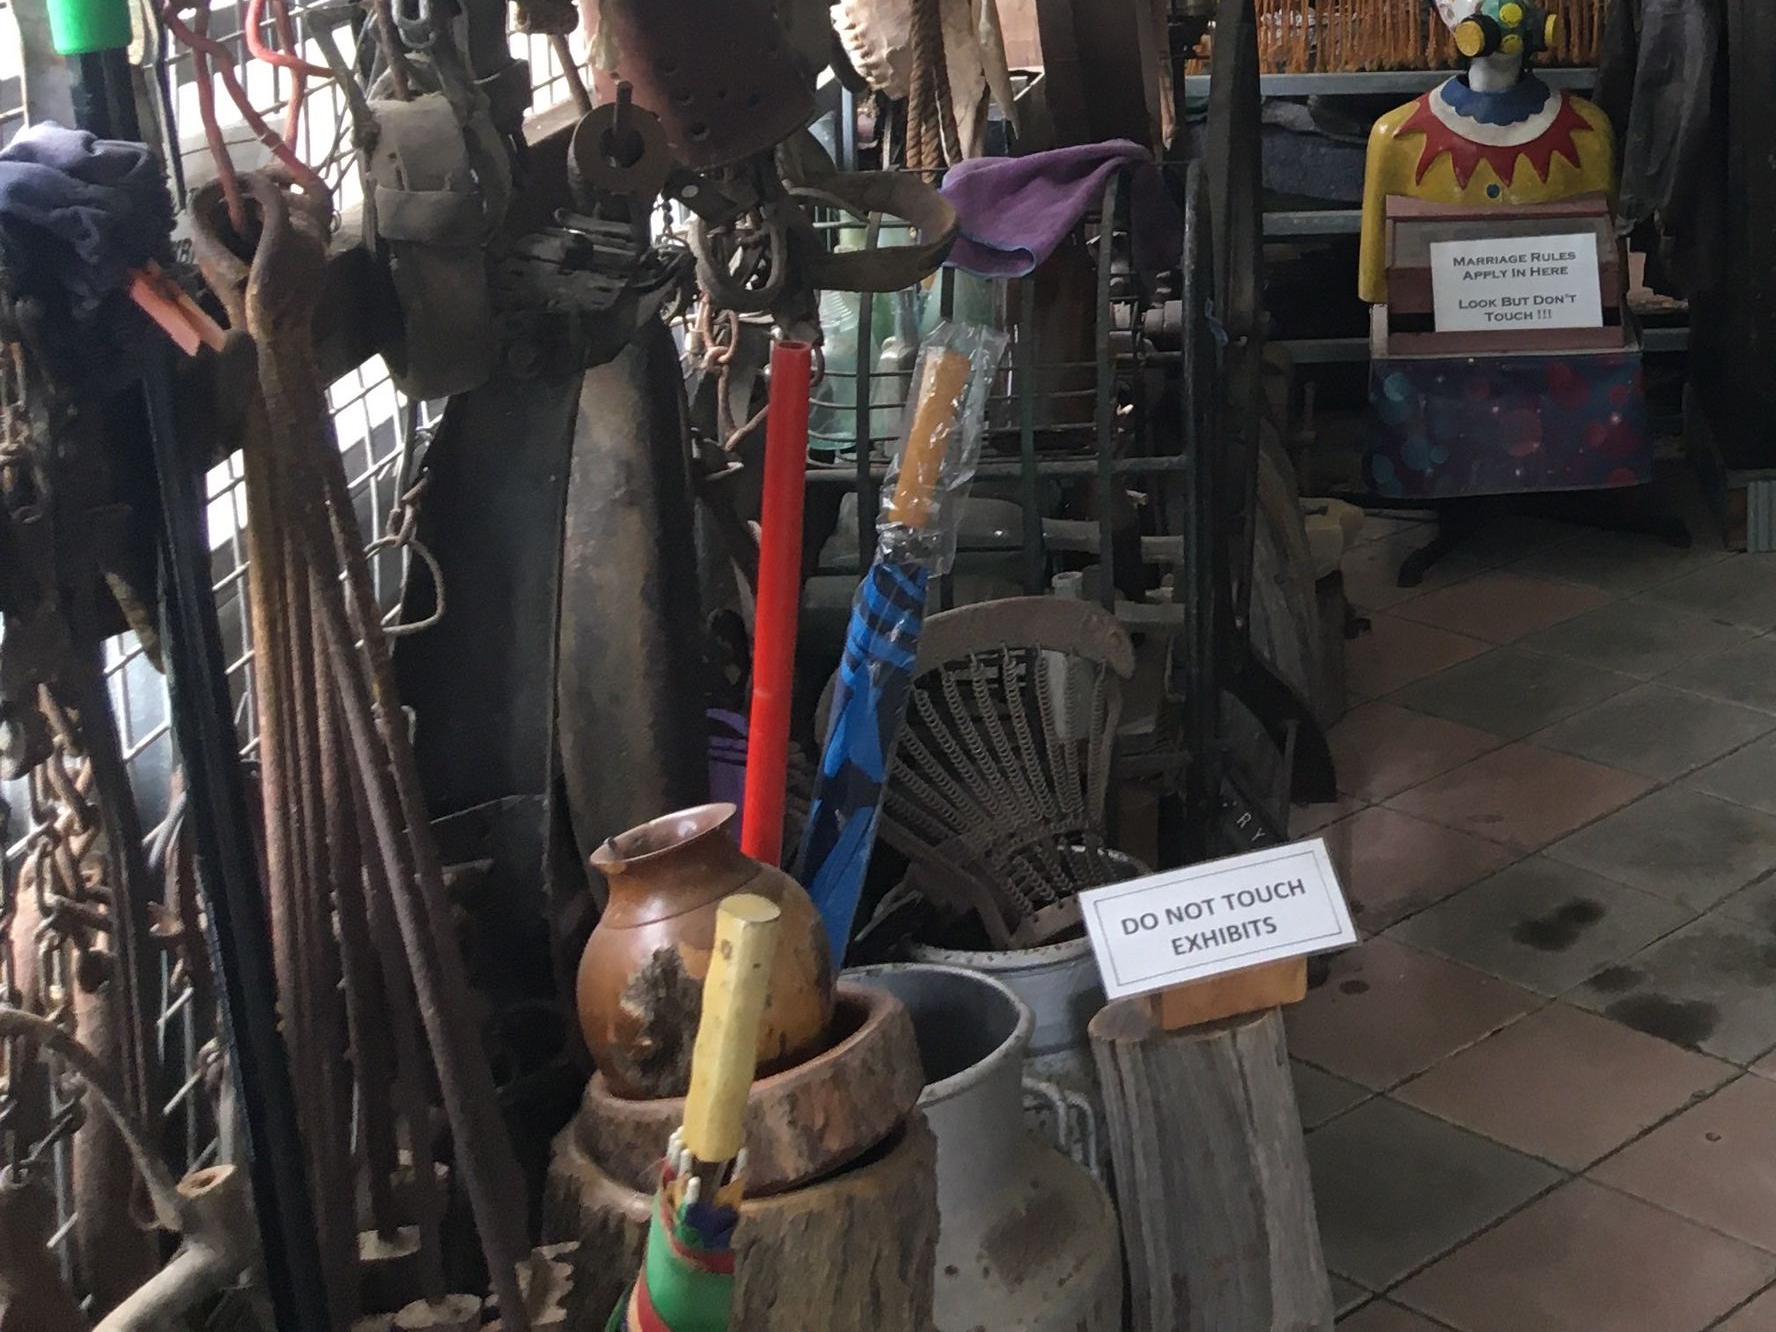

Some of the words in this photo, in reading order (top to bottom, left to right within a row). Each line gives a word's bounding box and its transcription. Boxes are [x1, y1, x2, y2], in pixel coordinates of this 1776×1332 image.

[1453, 254, 1527, 267] MARRIAGE
[1530, 252, 1576, 263] RULES
[1462, 269, 1508, 281] APPLY
[1511, 268, 1526, 278] IN
[1530, 266, 1568, 277] HERE
[1458, 298, 1497, 310] LOOK
[1501, 296, 1530, 308] BUT
[1533, 293, 1577, 305] DON'T
[1484, 310, 1533, 323] TOUCH
[1121, 912, 1159, 935] DO
[1164, 898, 1216, 925] NOT
[1220, 878, 1306, 911] TOUCH
[1170, 916, 1278, 956] EXHIBITS
